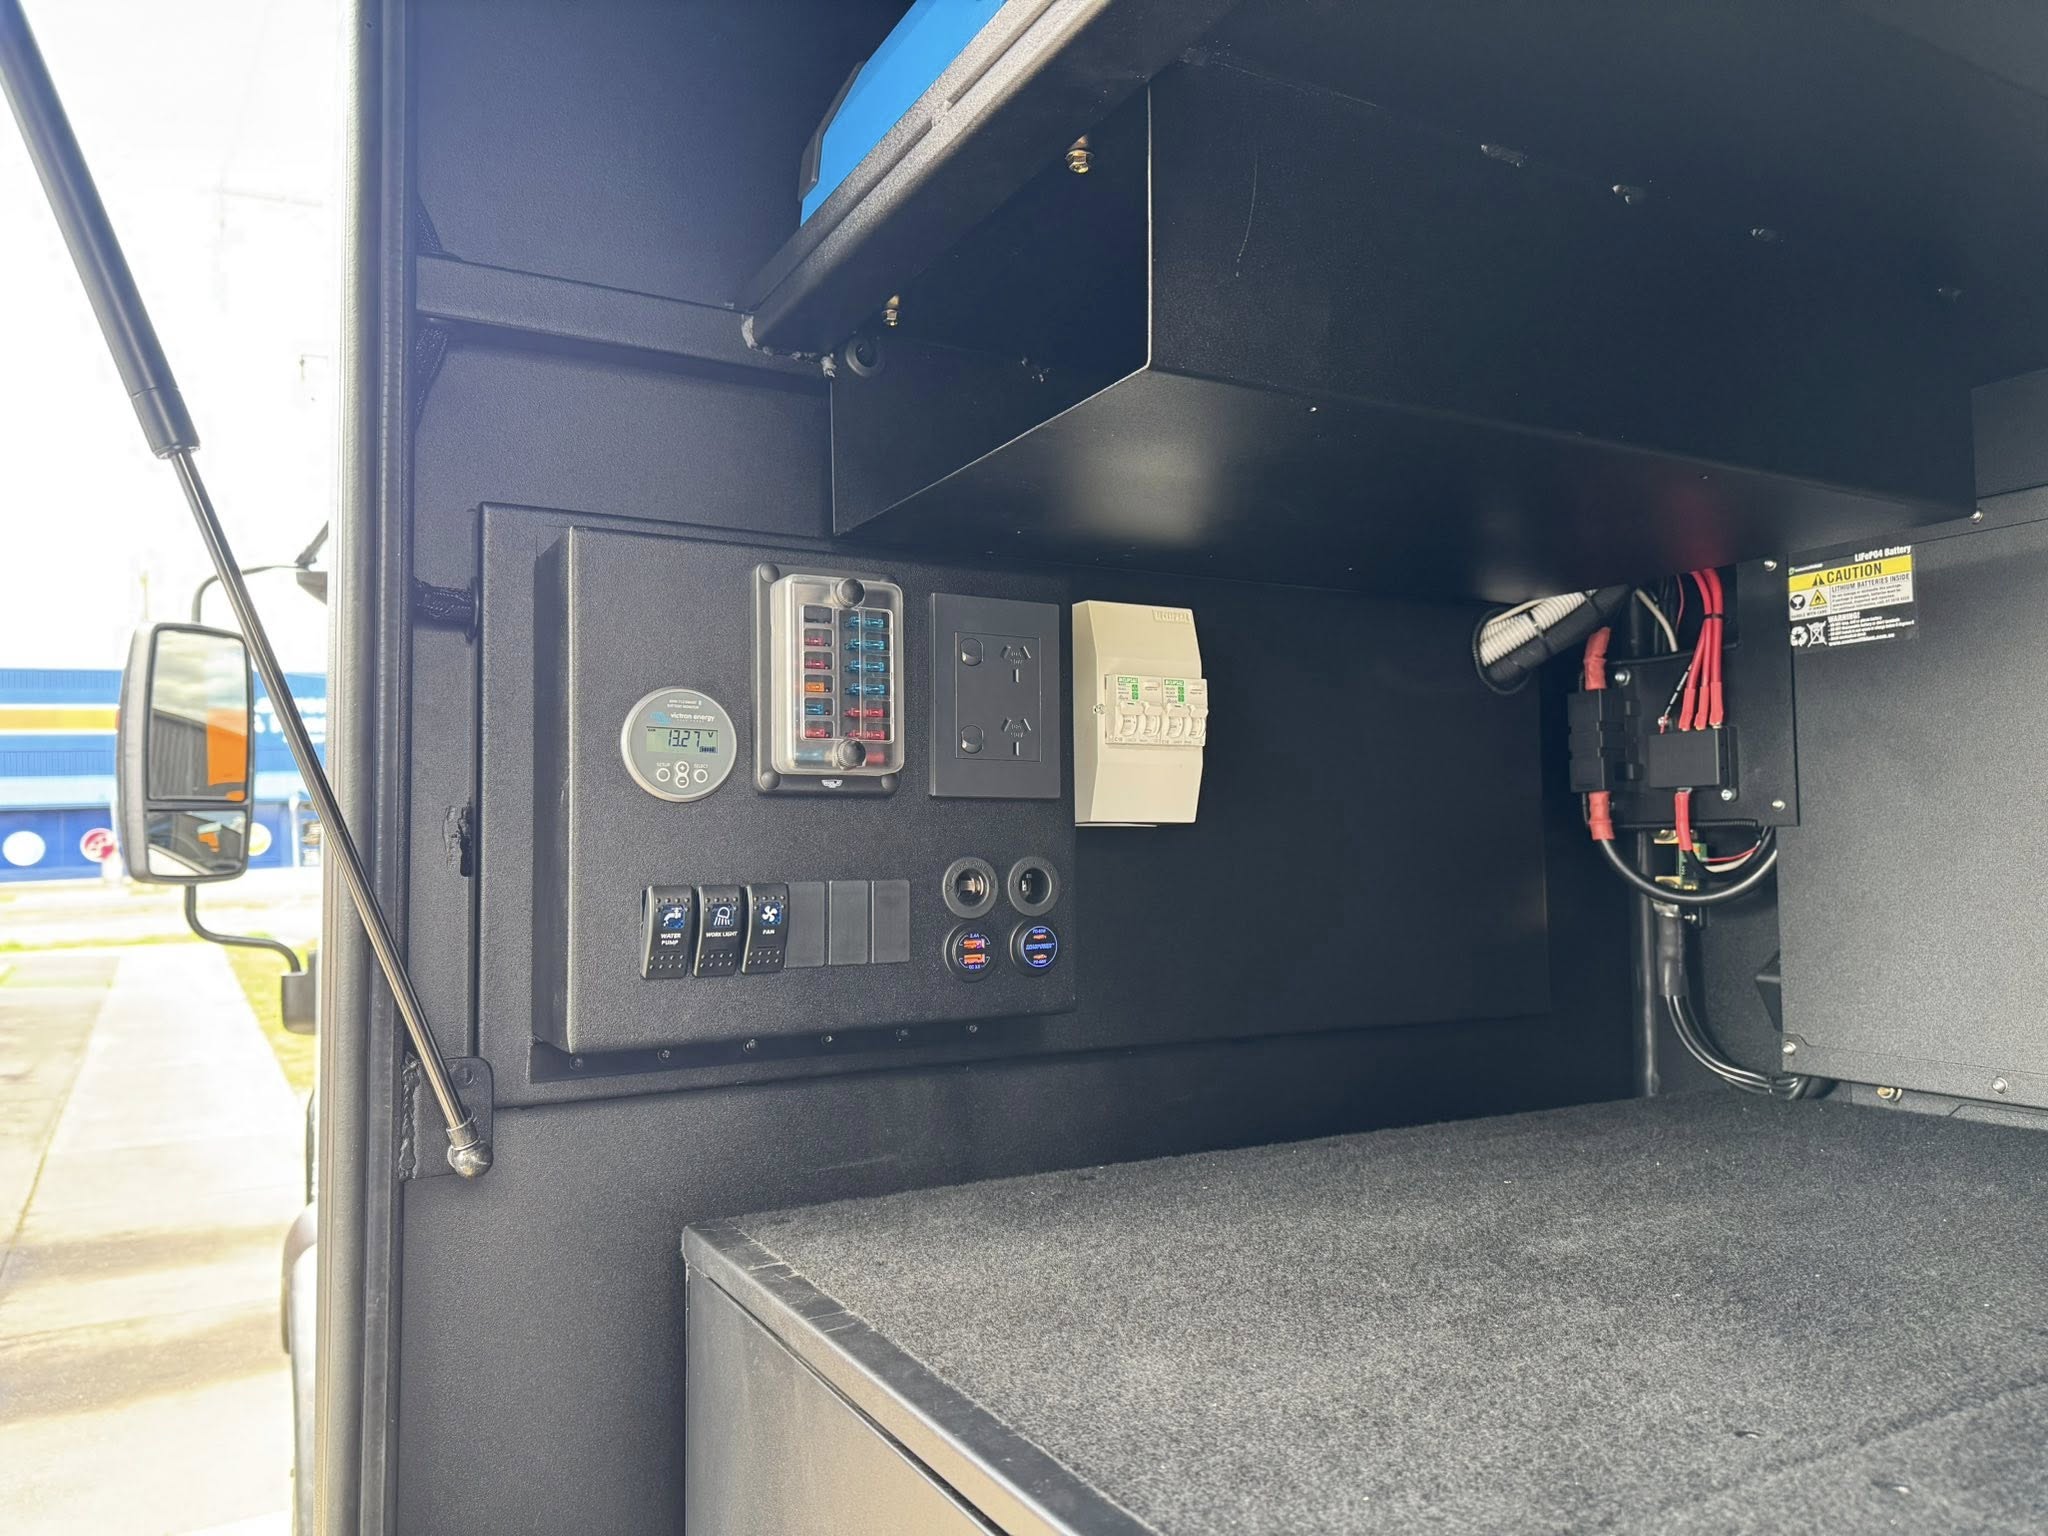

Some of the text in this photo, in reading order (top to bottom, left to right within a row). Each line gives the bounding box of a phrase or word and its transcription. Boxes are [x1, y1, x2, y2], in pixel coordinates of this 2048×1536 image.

[1884, 545, 1912, 557] Battery
[1826, 563, 1882, 584] CAUTION
[1831, 582, 1856, 593] LITHIUM
[1857, 577, 1889, 589] BATTERIES
[1889, 573, 1910, 583] INSIDE
[670, 712, 692, 720] victron
[693, 714, 715, 722] energy
